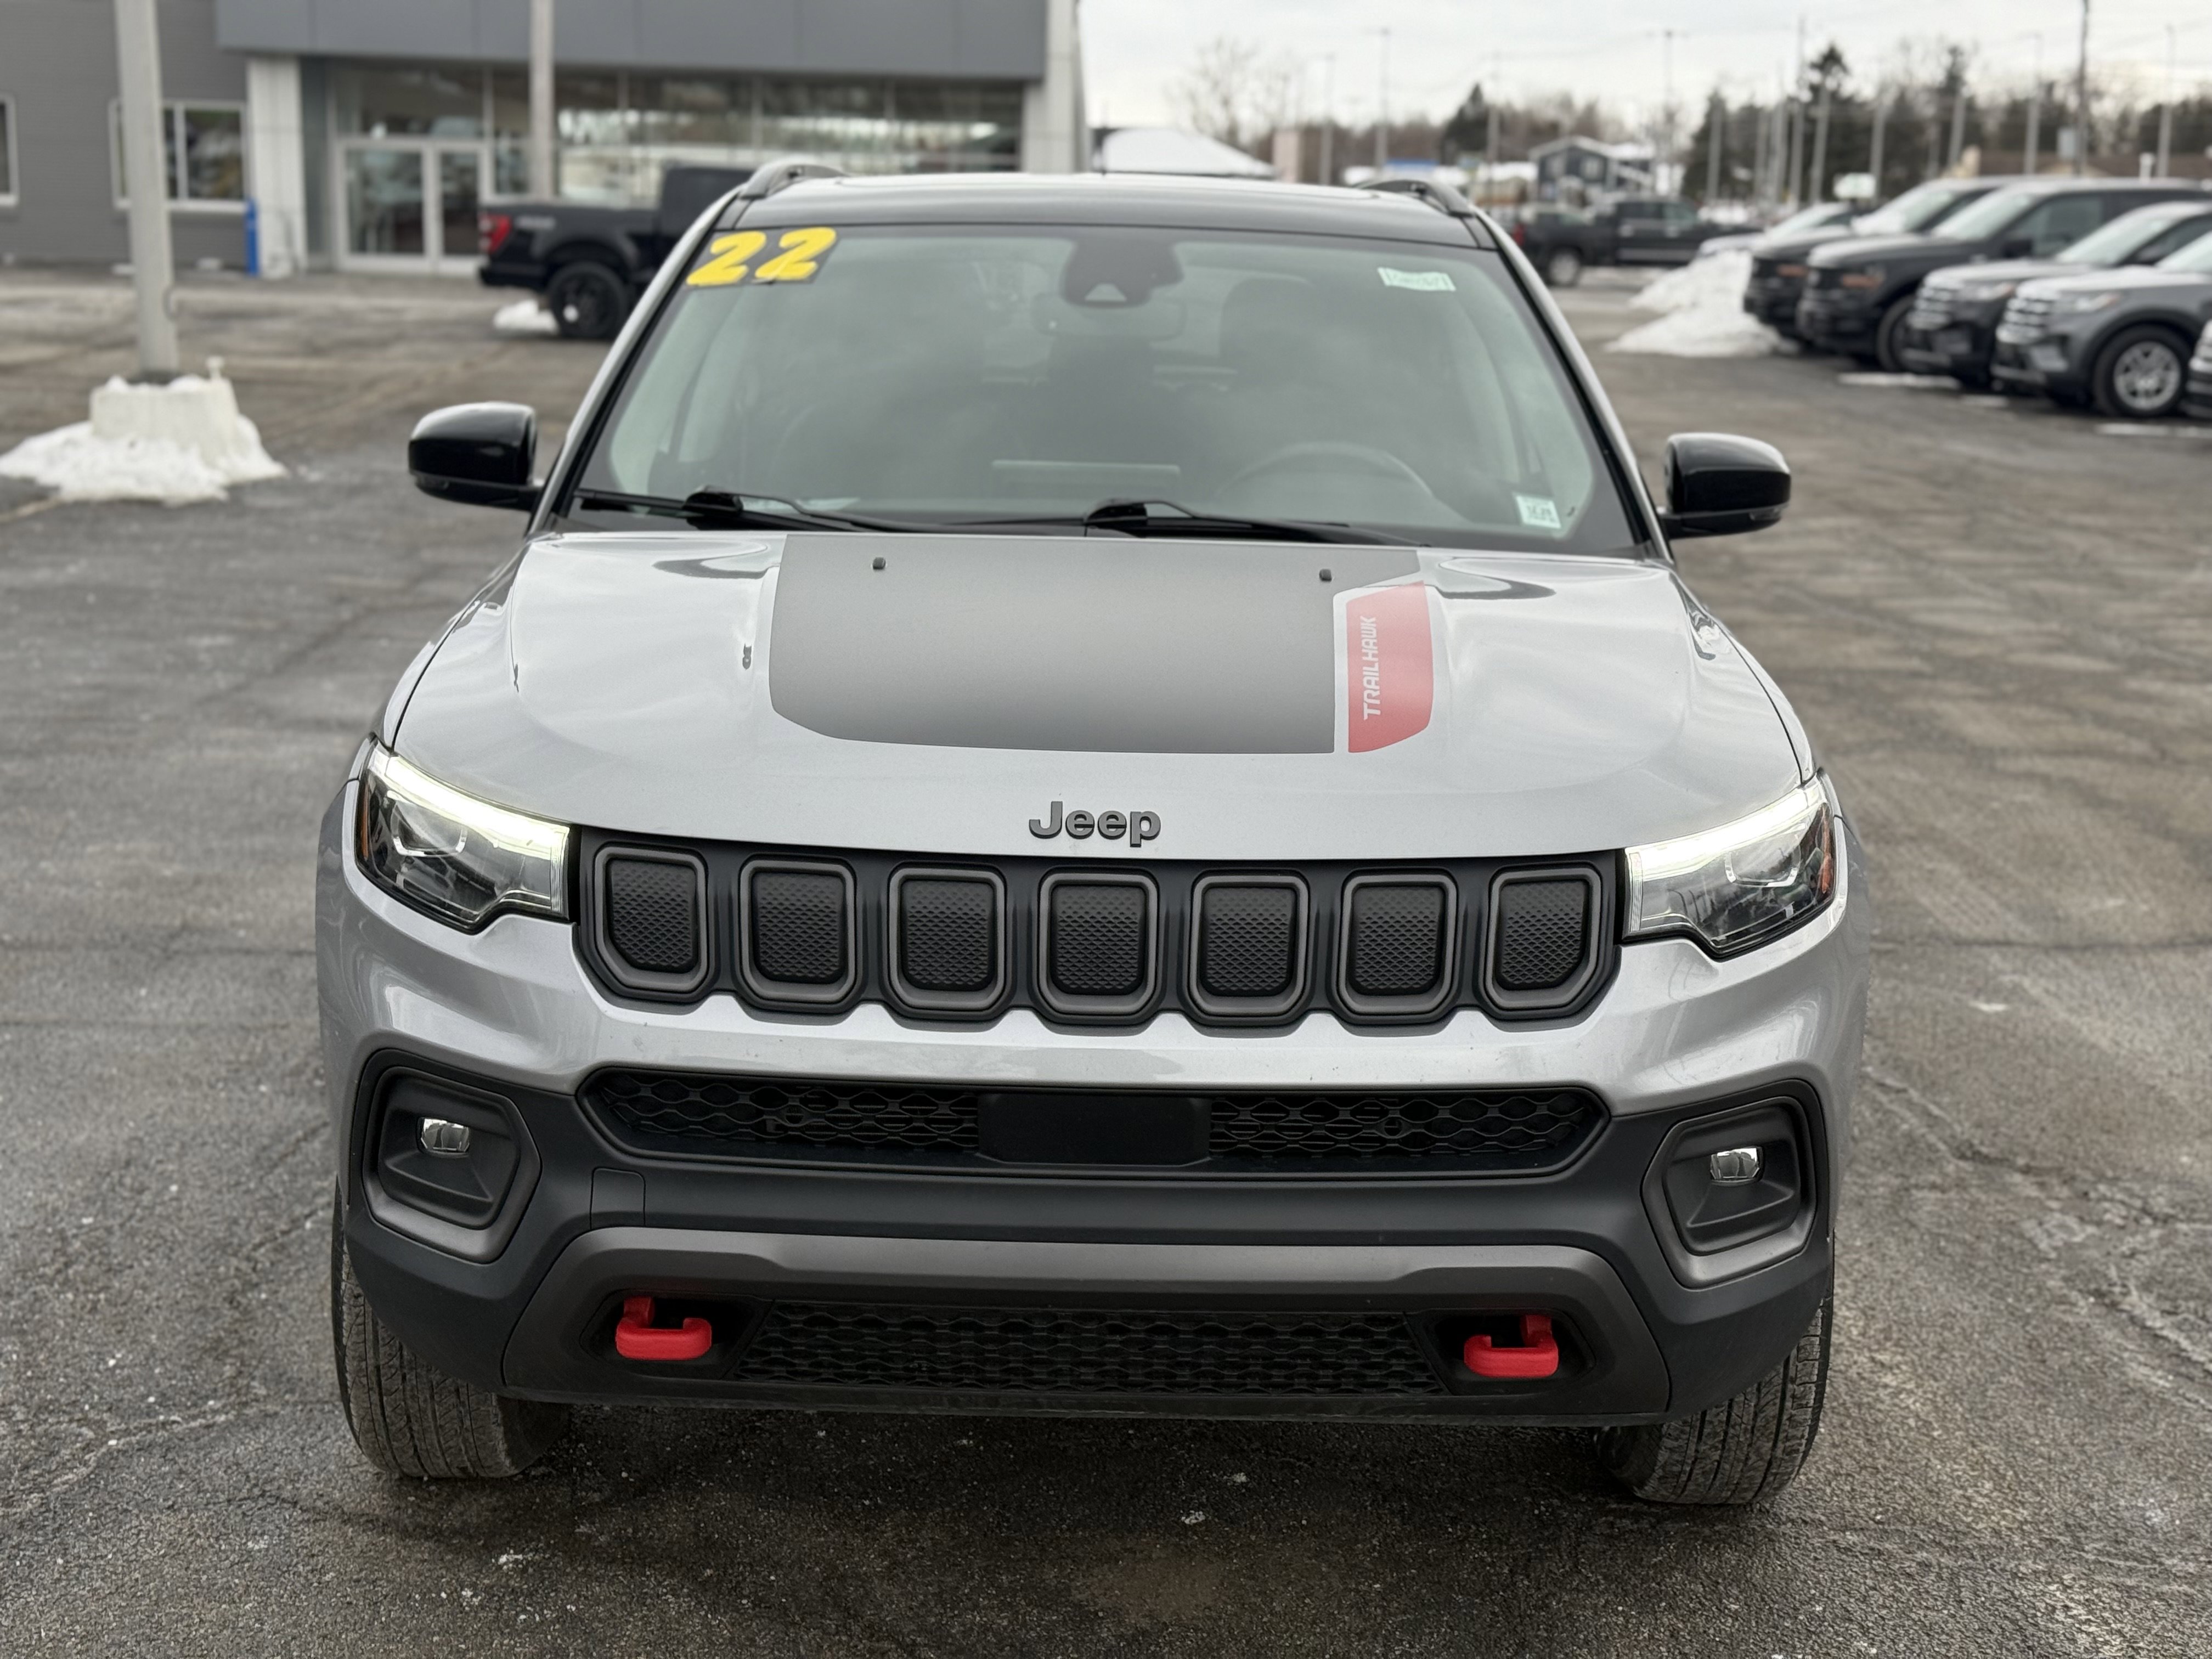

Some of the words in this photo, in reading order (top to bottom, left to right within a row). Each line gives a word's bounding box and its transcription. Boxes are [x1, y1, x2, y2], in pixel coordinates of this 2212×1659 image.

[687, 227, 837, 286] 22
[1359, 615, 1381, 720] TRAILHAWK
[1029, 801, 1161, 848] Jeep
